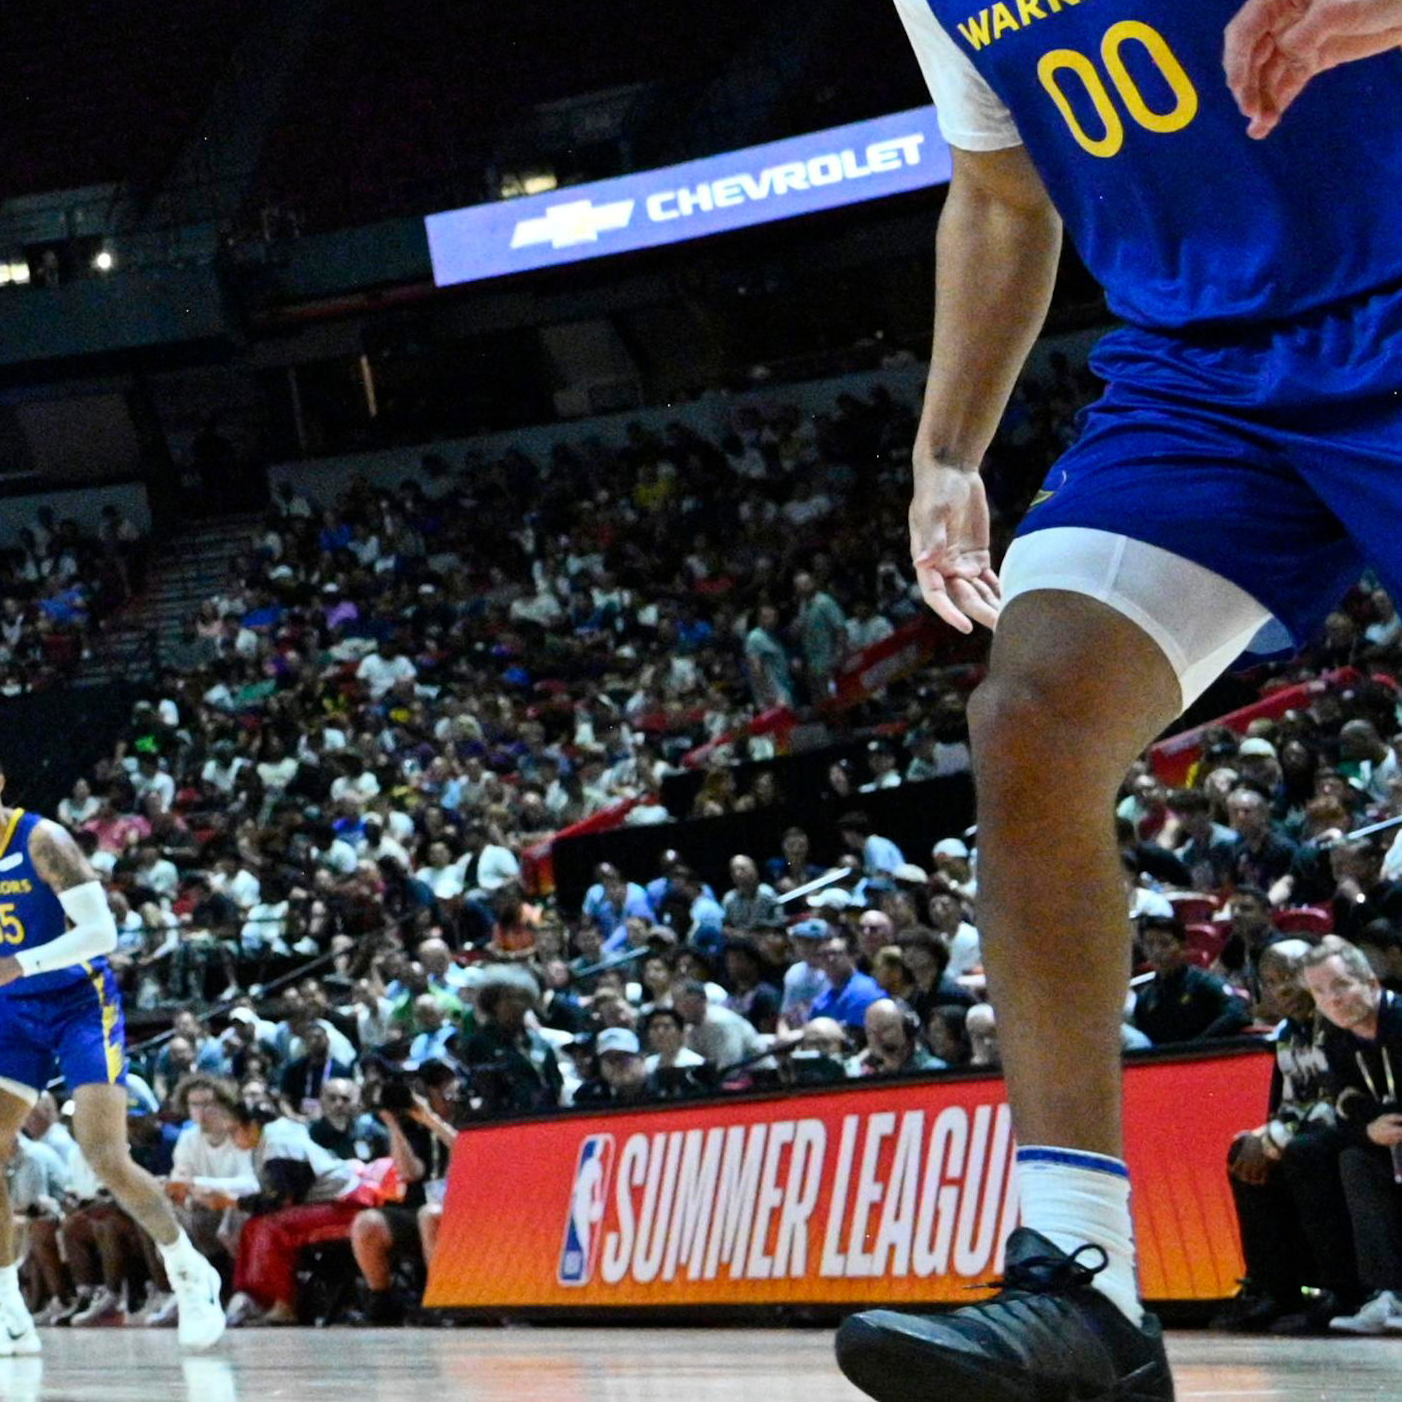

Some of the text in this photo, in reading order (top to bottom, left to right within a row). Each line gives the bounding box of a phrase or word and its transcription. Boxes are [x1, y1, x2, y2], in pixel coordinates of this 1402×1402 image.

[1037, 20, 1198, 159] 00
[646, 133, 925, 223] CHEVROLET
[602, 1117, 827, 1284] SUMMER
